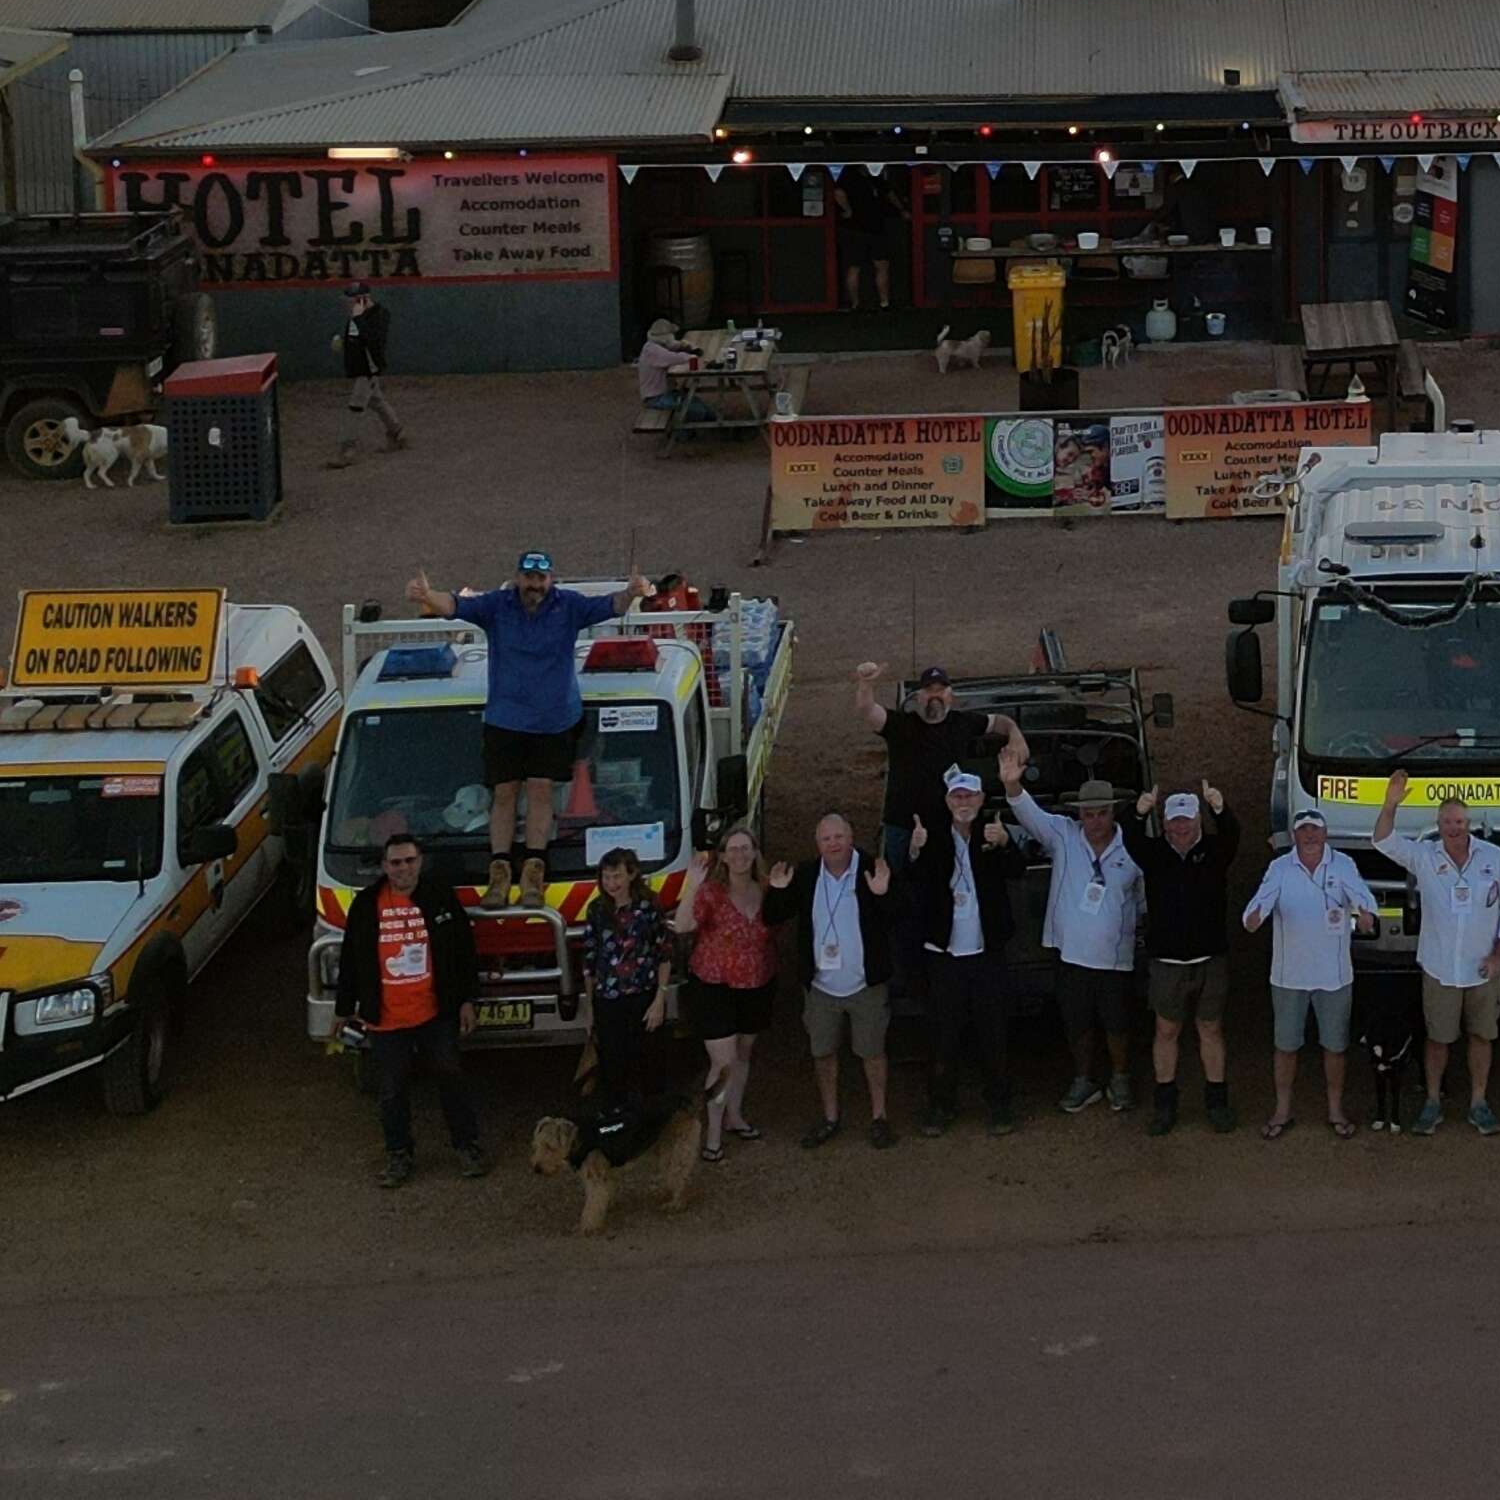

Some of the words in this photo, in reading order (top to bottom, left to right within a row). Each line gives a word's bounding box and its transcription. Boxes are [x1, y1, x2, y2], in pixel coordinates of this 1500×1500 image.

[1334, 123, 1384, 141] THE
[433, 174, 519, 187] Travellers
[525, 171, 605, 185] Welcome
[460, 197, 580, 211] Accomodation
[459, 223, 527, 237] Counter
[533, 221, 581, 234] Meals
[453, 249, 494, 261] Take
[498, 248, 545, 261] Away
[551, 245, 591, 258] Food
[202, 248, 422, 281] NADATTA
[1168, 411, 1295, 436] OODNADATTA
[1304, 407, 1368, 431] HOTEL
[774, 422, 906, 447] OODNADATTA
[915, 419, 980, 444] HOTEL
[1225, 439, 1312, 451] Accomodation
[834, 451, 924, 464] Accomodation
[1224, 455, 1272, 465] Counter
[833, 467, 883, 477] Counter
[887, 466, 924, 476] Meals
[1214, 470, 1250, 480] Lunch
[822, 482, 860, 492] Lunch
[864, 482, 888, 491] and
[892, 481, 935, 491] Dinner
[1196, 486, 1225, 496] Take
[803, 498, 833, 508] Take
[837, 497, 873, 508] Away
[876, 496, 906, 506] Food
[910, 495, 926, 505] All
[930, 494, 954, 506] Day
[1211, 499, 1238, 509] Cold
[1243, 498, 1270, 509] Beer
[819, 510, 847, 522] Cold
[851, 510, 880, 521] Beer
[884, 509, 894, 520] &
[898, 509, 938, 520] Drinks
[42, 603, 114, 628] CAUTION
[118, 601, 198, 627] WALKERS
[25, 649, 49, 674] ON
[53, 648, 99, 673] ROAD
[104, 646, 201, 672] FOLLOWING
[1320, 778, 1358, 799] FIRE
